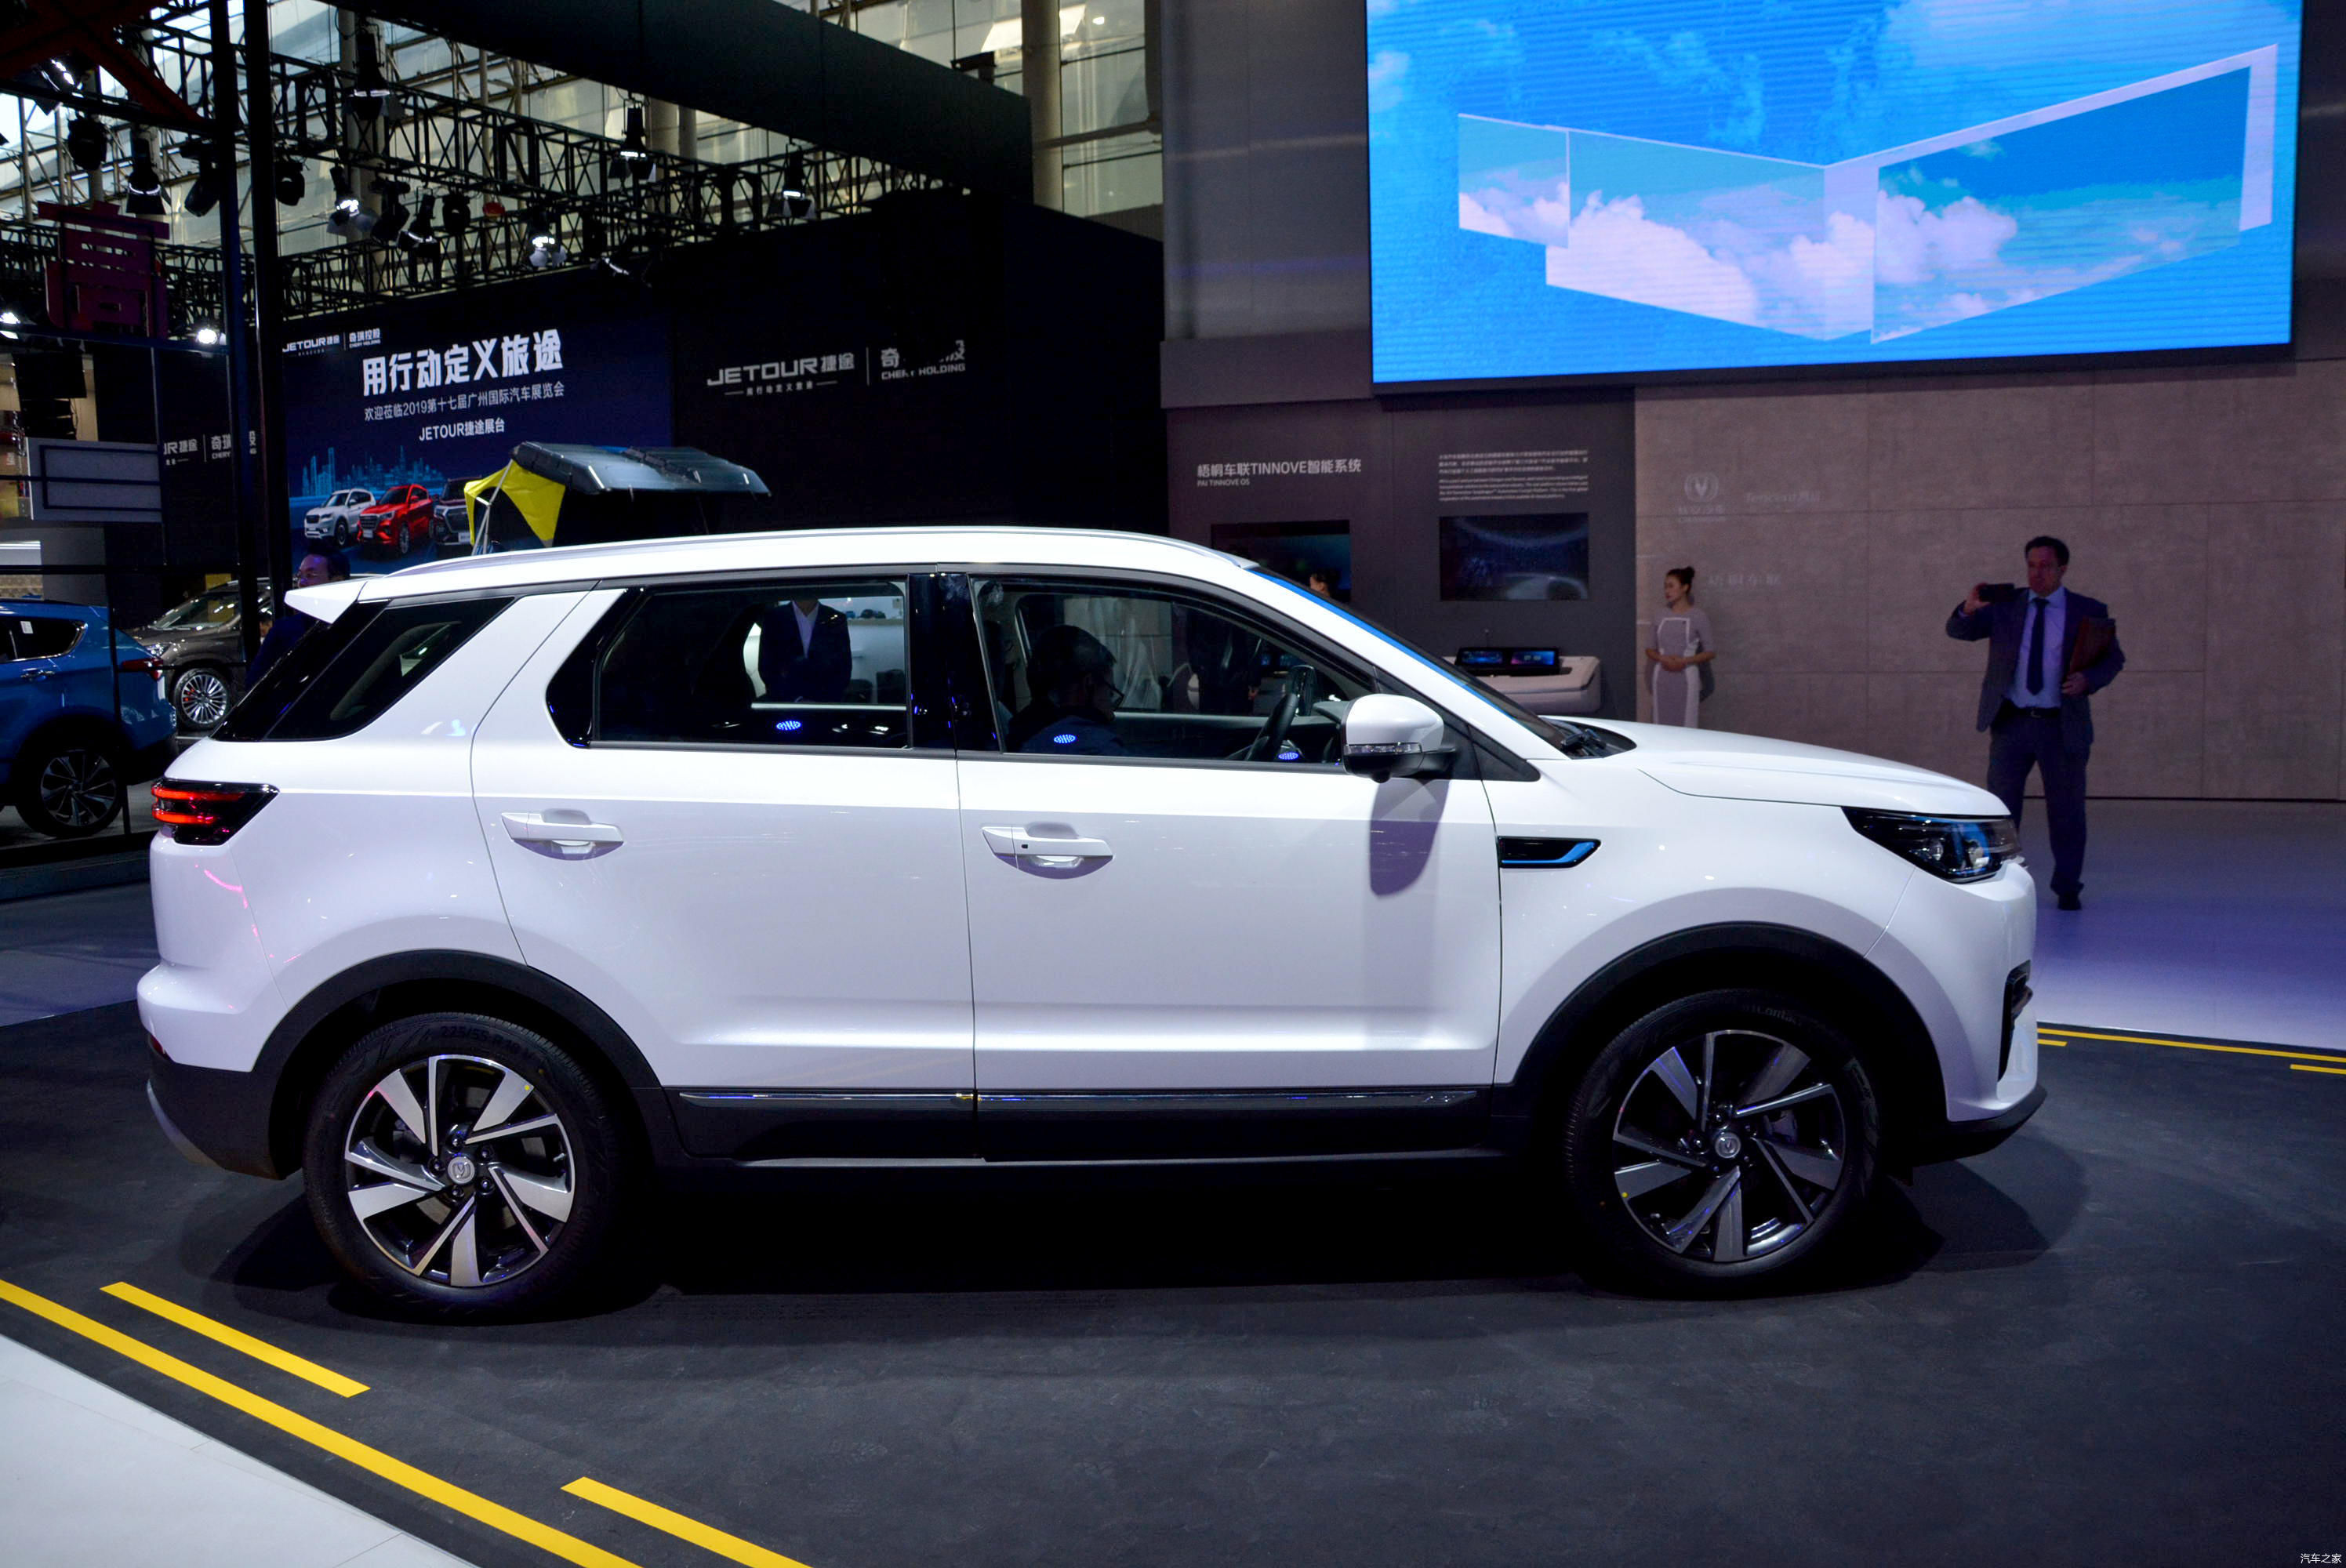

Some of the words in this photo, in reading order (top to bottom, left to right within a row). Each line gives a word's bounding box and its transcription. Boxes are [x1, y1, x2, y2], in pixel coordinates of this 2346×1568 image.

[362, 328, 564, 397] 用行动定义旅途
[707, 352, 855, 387] JETOUR捷途
[918, 363, 966, 376] HOLDING
[419, 417, 505, 441] JETOUR捷途展台
